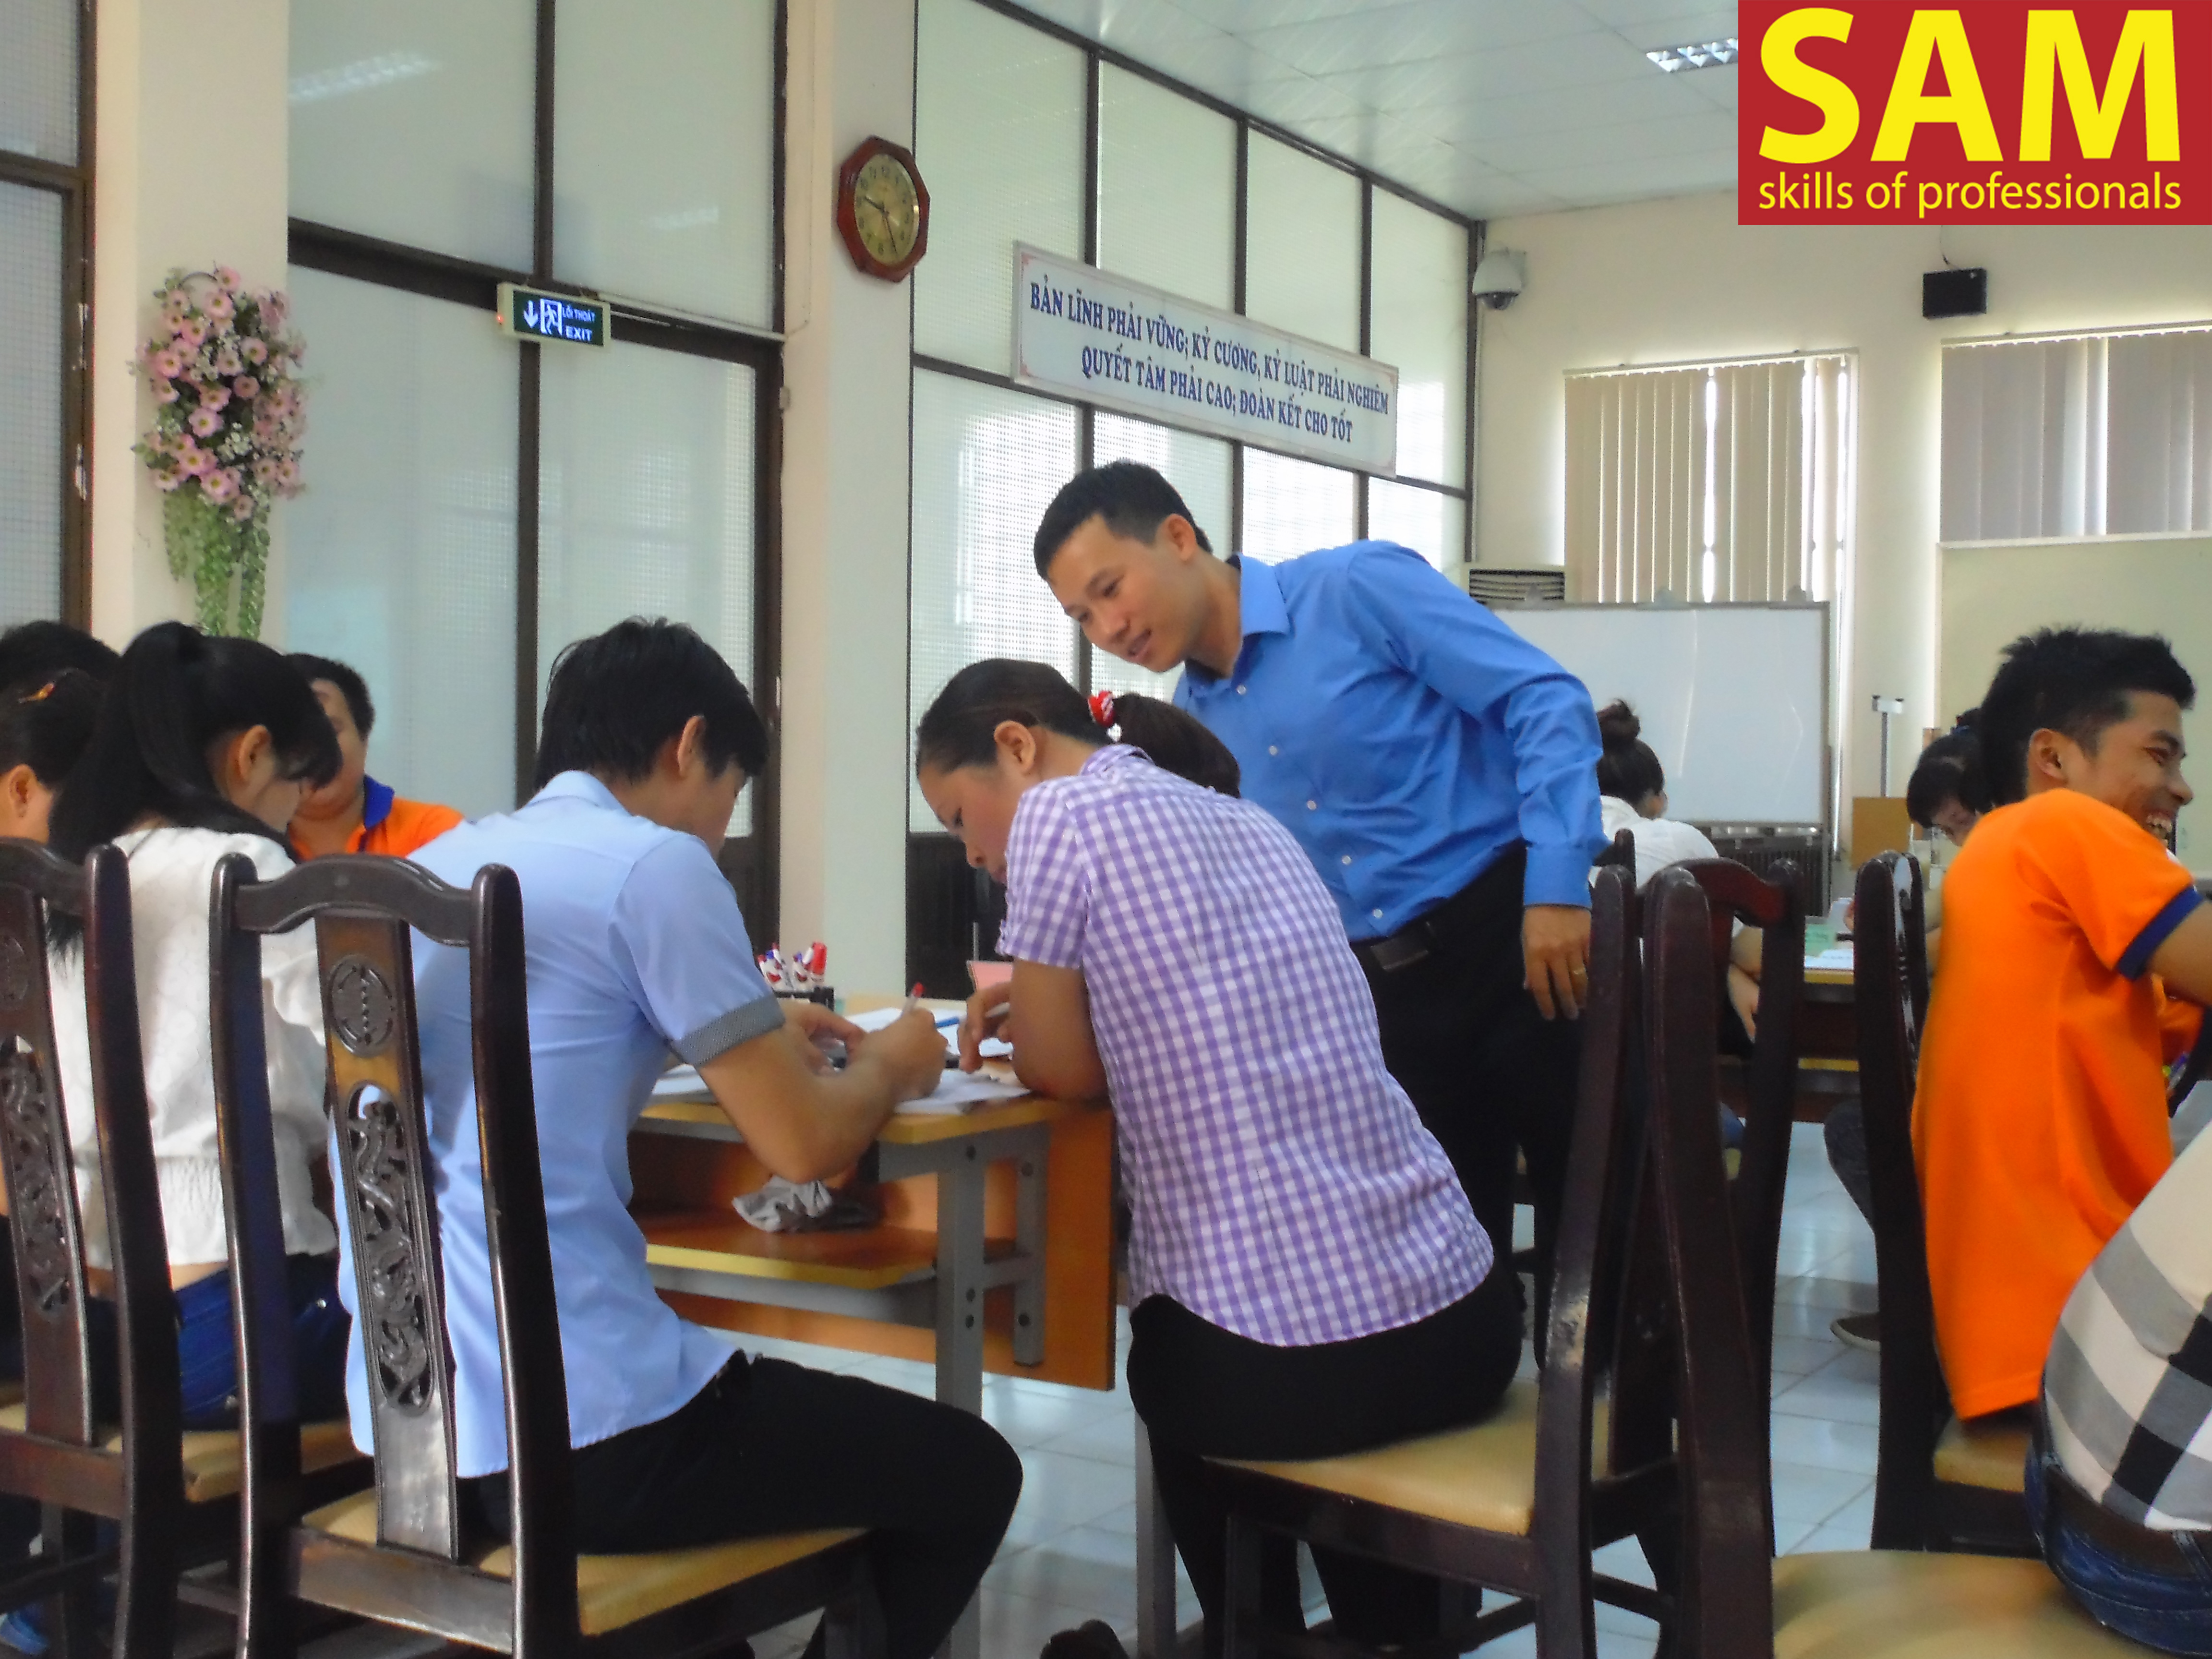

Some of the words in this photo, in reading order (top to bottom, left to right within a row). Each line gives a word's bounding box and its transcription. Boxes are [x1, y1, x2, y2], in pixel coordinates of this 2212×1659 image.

[565, 325, 592, 341] EXIT
[1031, 274, 1063, 317] BẢN
[1068, 288, 1104, 329] LĨNH
[1107, 301, 1142, 340] PHẢI
[1146, 314, 1188, 360] VỮNG;
[1192, 326, 1210, 360] KỶ
[1214, 340, 1261, 381] CƯƠNG,
[1284, 360, 1315, 396] LUẬT
[1318, 367, 1345, 401] PHẢI
[1347, 382, 1389, 415] NGHIÊM
[1082, 342, 1132, 383] QUYẾT
[1136, 356, 1166, 392] TÂM
[1170, 364, 1202, 402] PHẢI
[1206, 381, 1237, 417] CAO;
[1239, 387, 1275, 421] ĐOÀN
[1278, 393, 1302, 428] KẾT
[1305, 409, 1328, 435] CHO
[1331, 408, 1353, 443] TỐT
